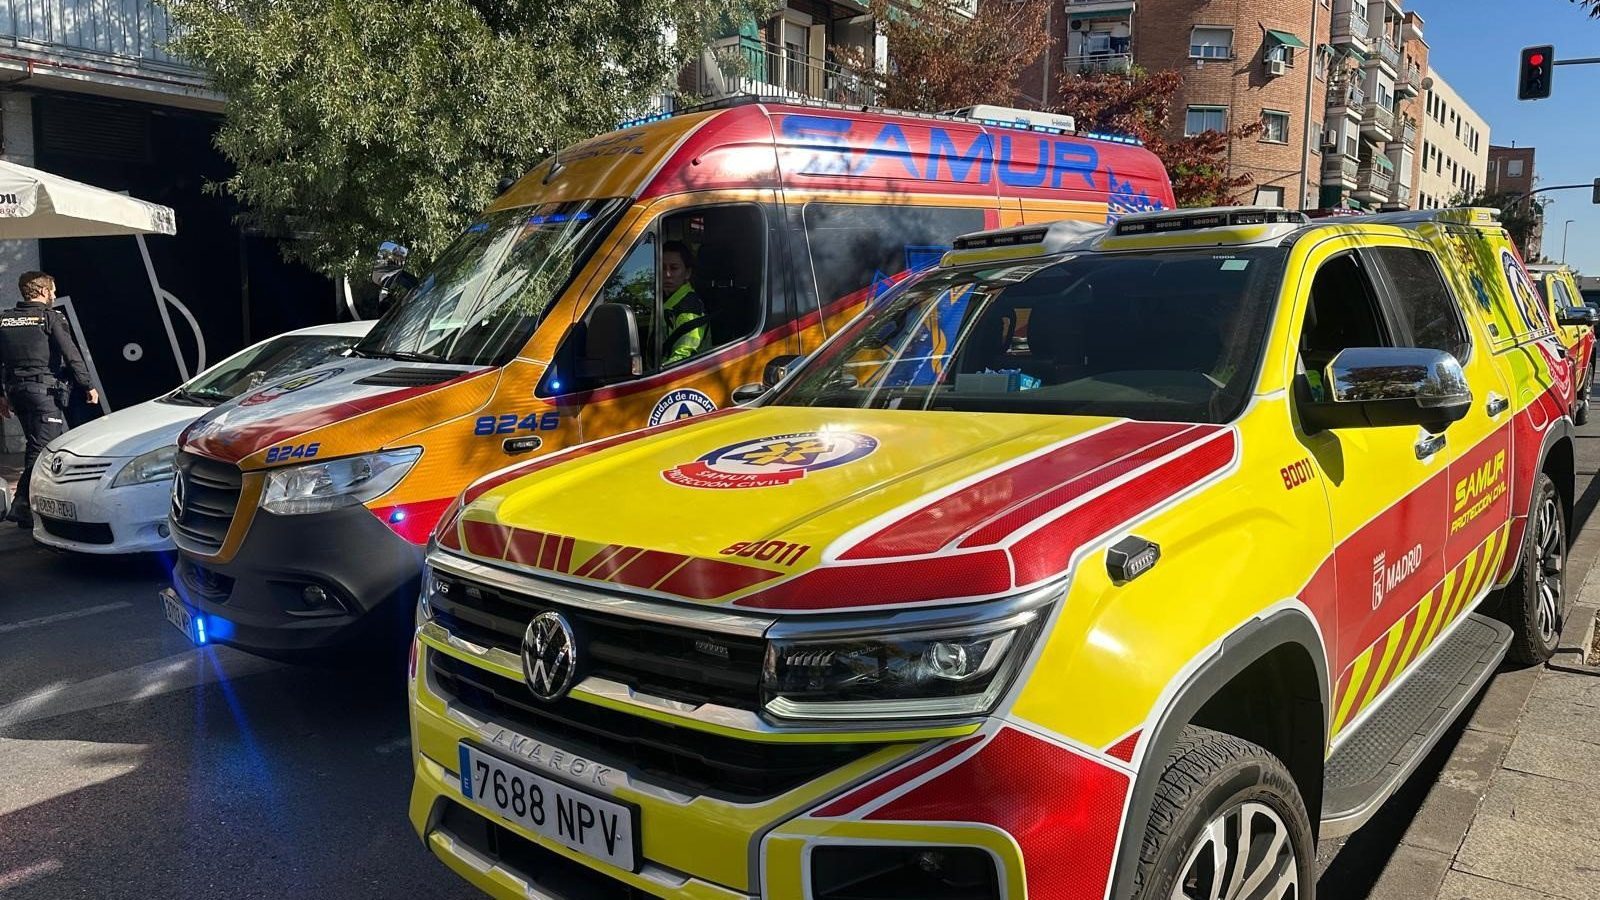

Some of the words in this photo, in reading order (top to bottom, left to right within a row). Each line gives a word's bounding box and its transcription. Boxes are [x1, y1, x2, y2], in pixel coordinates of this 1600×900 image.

[781, 115, 1099, 189] SAMUR
[474, 411, 560, 436] 8246
[651, 396, 674, 426] ciudad
[675, 392, 687, 401] de
[689, 393, 715, 412] madri
[264, 443, 320, 463] 8246
[696, 470, 758, 481] SAMUR
[736, 480, 785, 488] CIVIL
[1280, 458, 1315, 490] 80011
[1454, 449, 1505, 513] SAMUR
[719, 540, 812, 567] 80011
[1385, 543, 1422, 594] MADRID
[436, 581, 449, 593] V6
[491, 729, 612, 787] AMAROK
[476, 760, 545, 826] 7688
[556, 793, 618, 856] NPV
